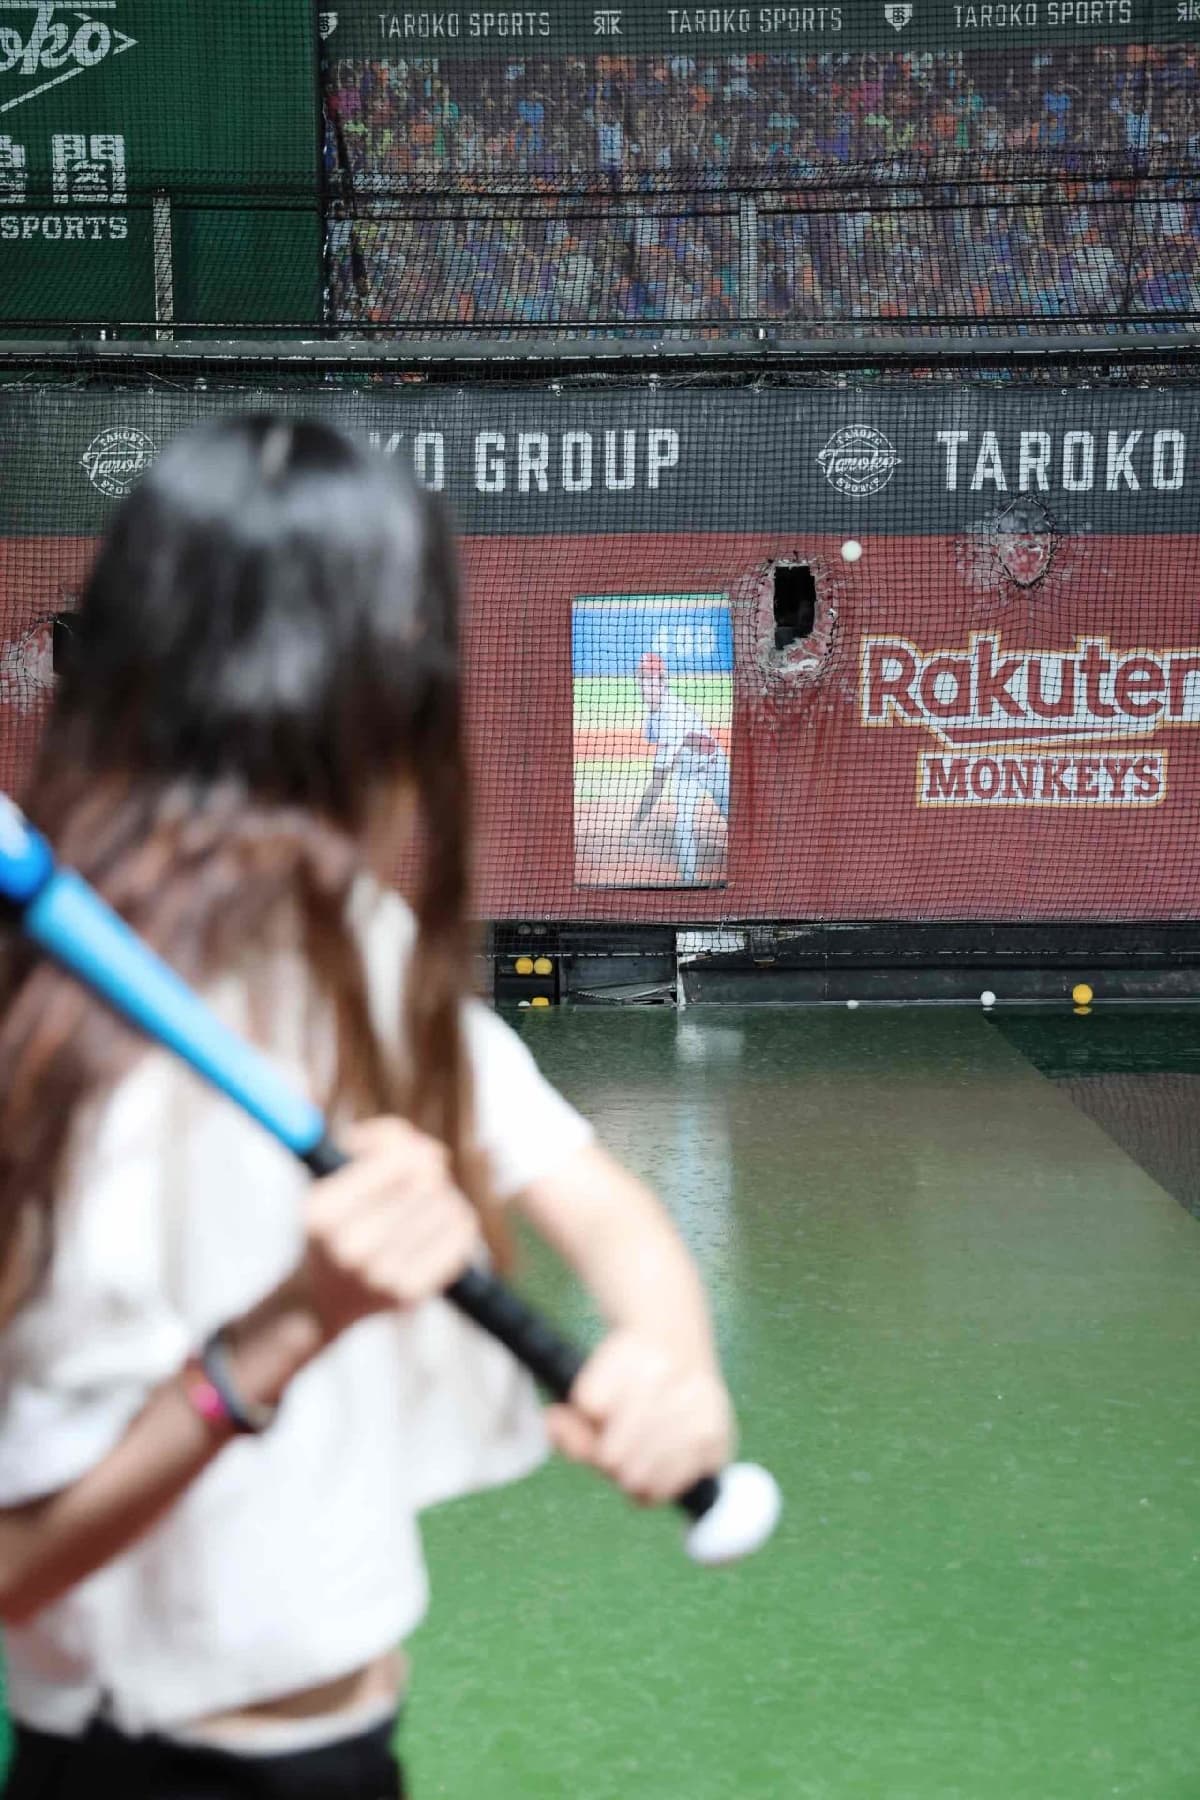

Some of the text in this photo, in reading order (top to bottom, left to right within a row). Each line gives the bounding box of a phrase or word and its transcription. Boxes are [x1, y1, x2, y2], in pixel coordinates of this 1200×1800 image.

[378, 11, 550, 38] TAROKO SPORTS
[667, 7, 842, 34] TAROKO SPORTS
[953, 0, 1131, 28] TAROKO SPORTS
[0, 216, 128, 239] SPORTS
[475, 428, 679, 492] GROUP
[936, 430, 1185, 491] TAROKO
[925, 757, 1160, 799] MONKEYS
